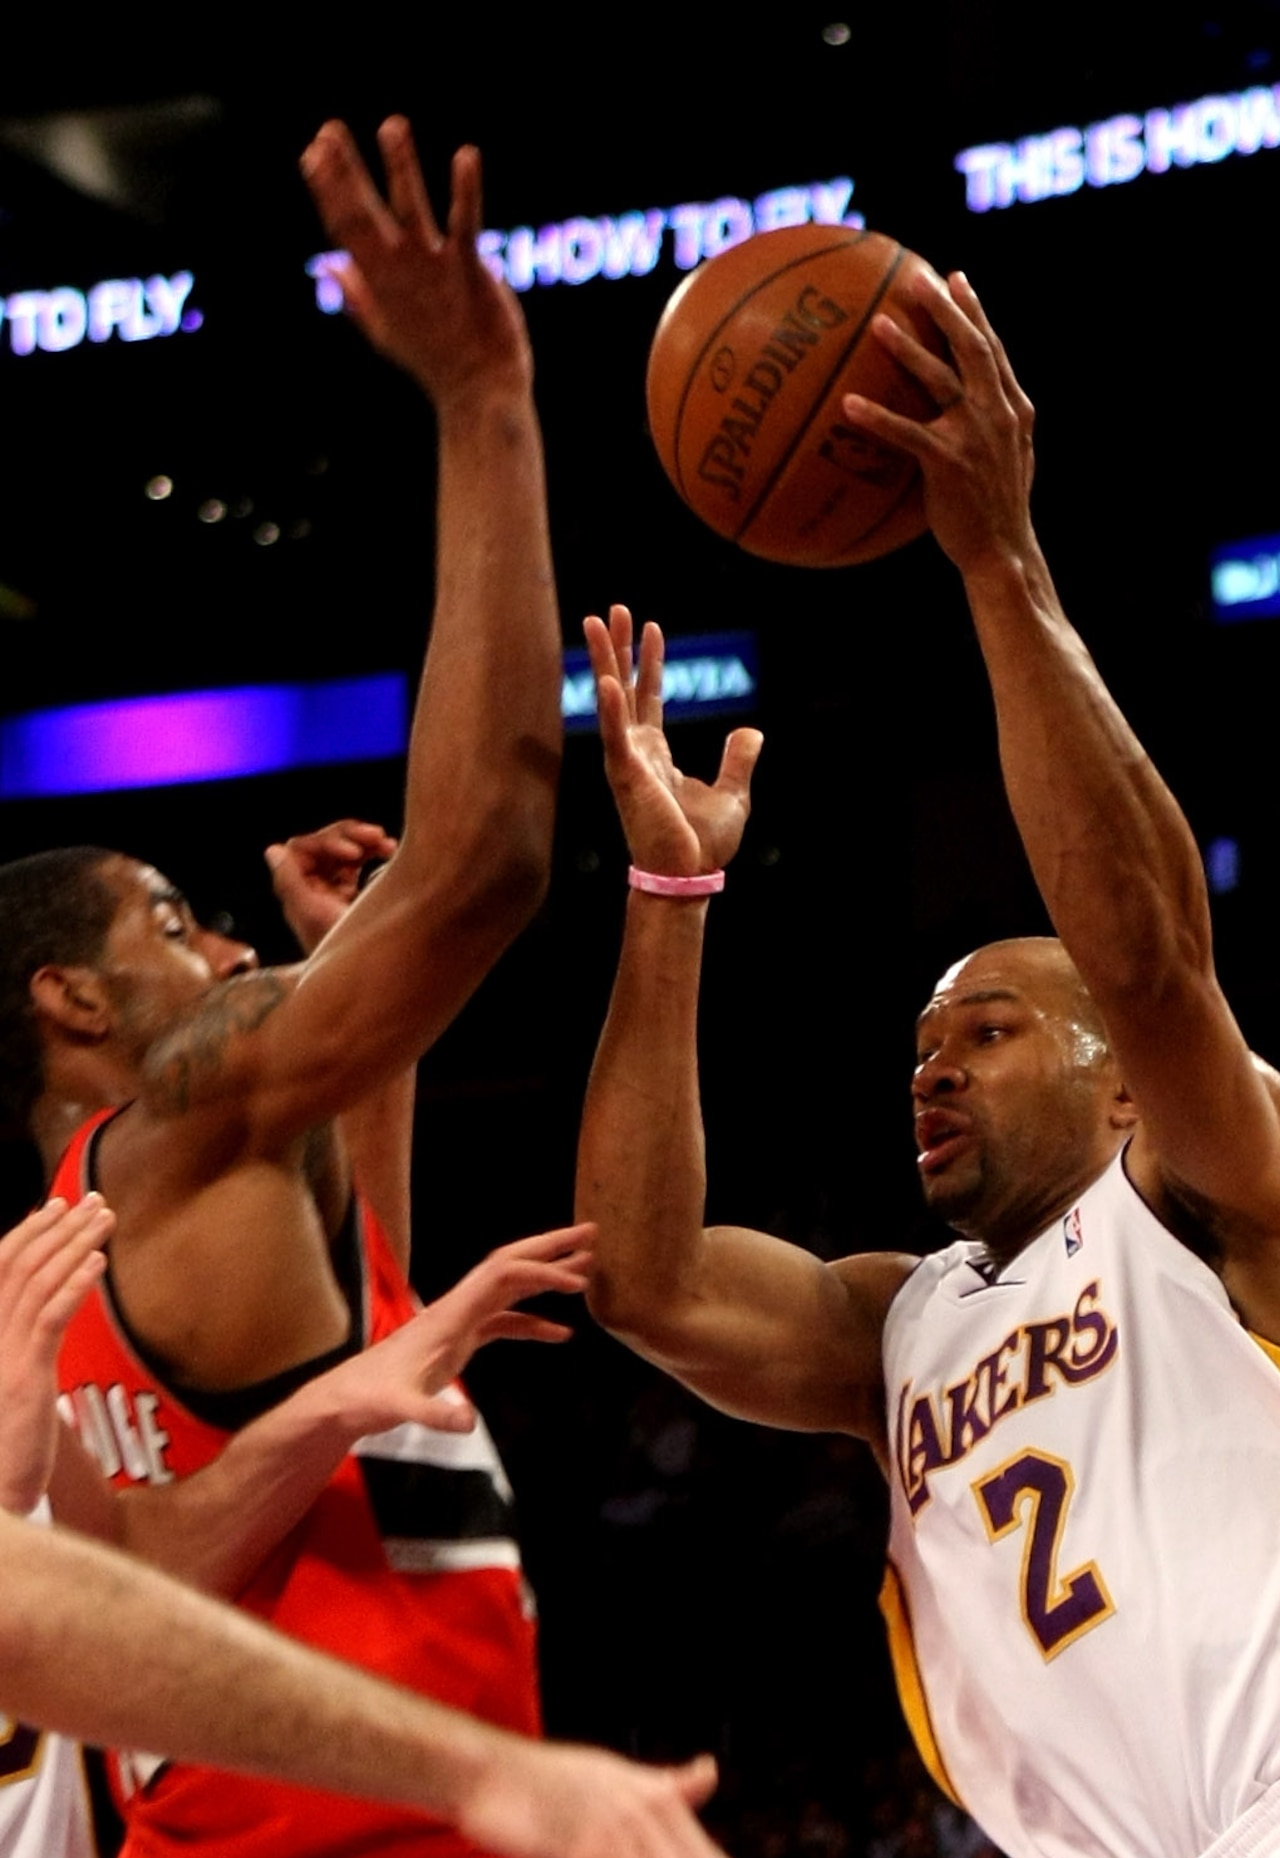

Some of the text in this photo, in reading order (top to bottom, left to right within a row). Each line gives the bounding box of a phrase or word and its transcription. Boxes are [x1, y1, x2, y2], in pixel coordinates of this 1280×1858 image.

[955, 124, 1085, 213] THIS
[1085, 113, 1146, 187] IS
[506, 208, 668, 292] HOW
[667, 196, 756, 270] TO
[5, 269, 205, 357] TO FLY.
[697, 283, 849, 502] SPALDING
[970, 1445, 1118, 1665] 2
